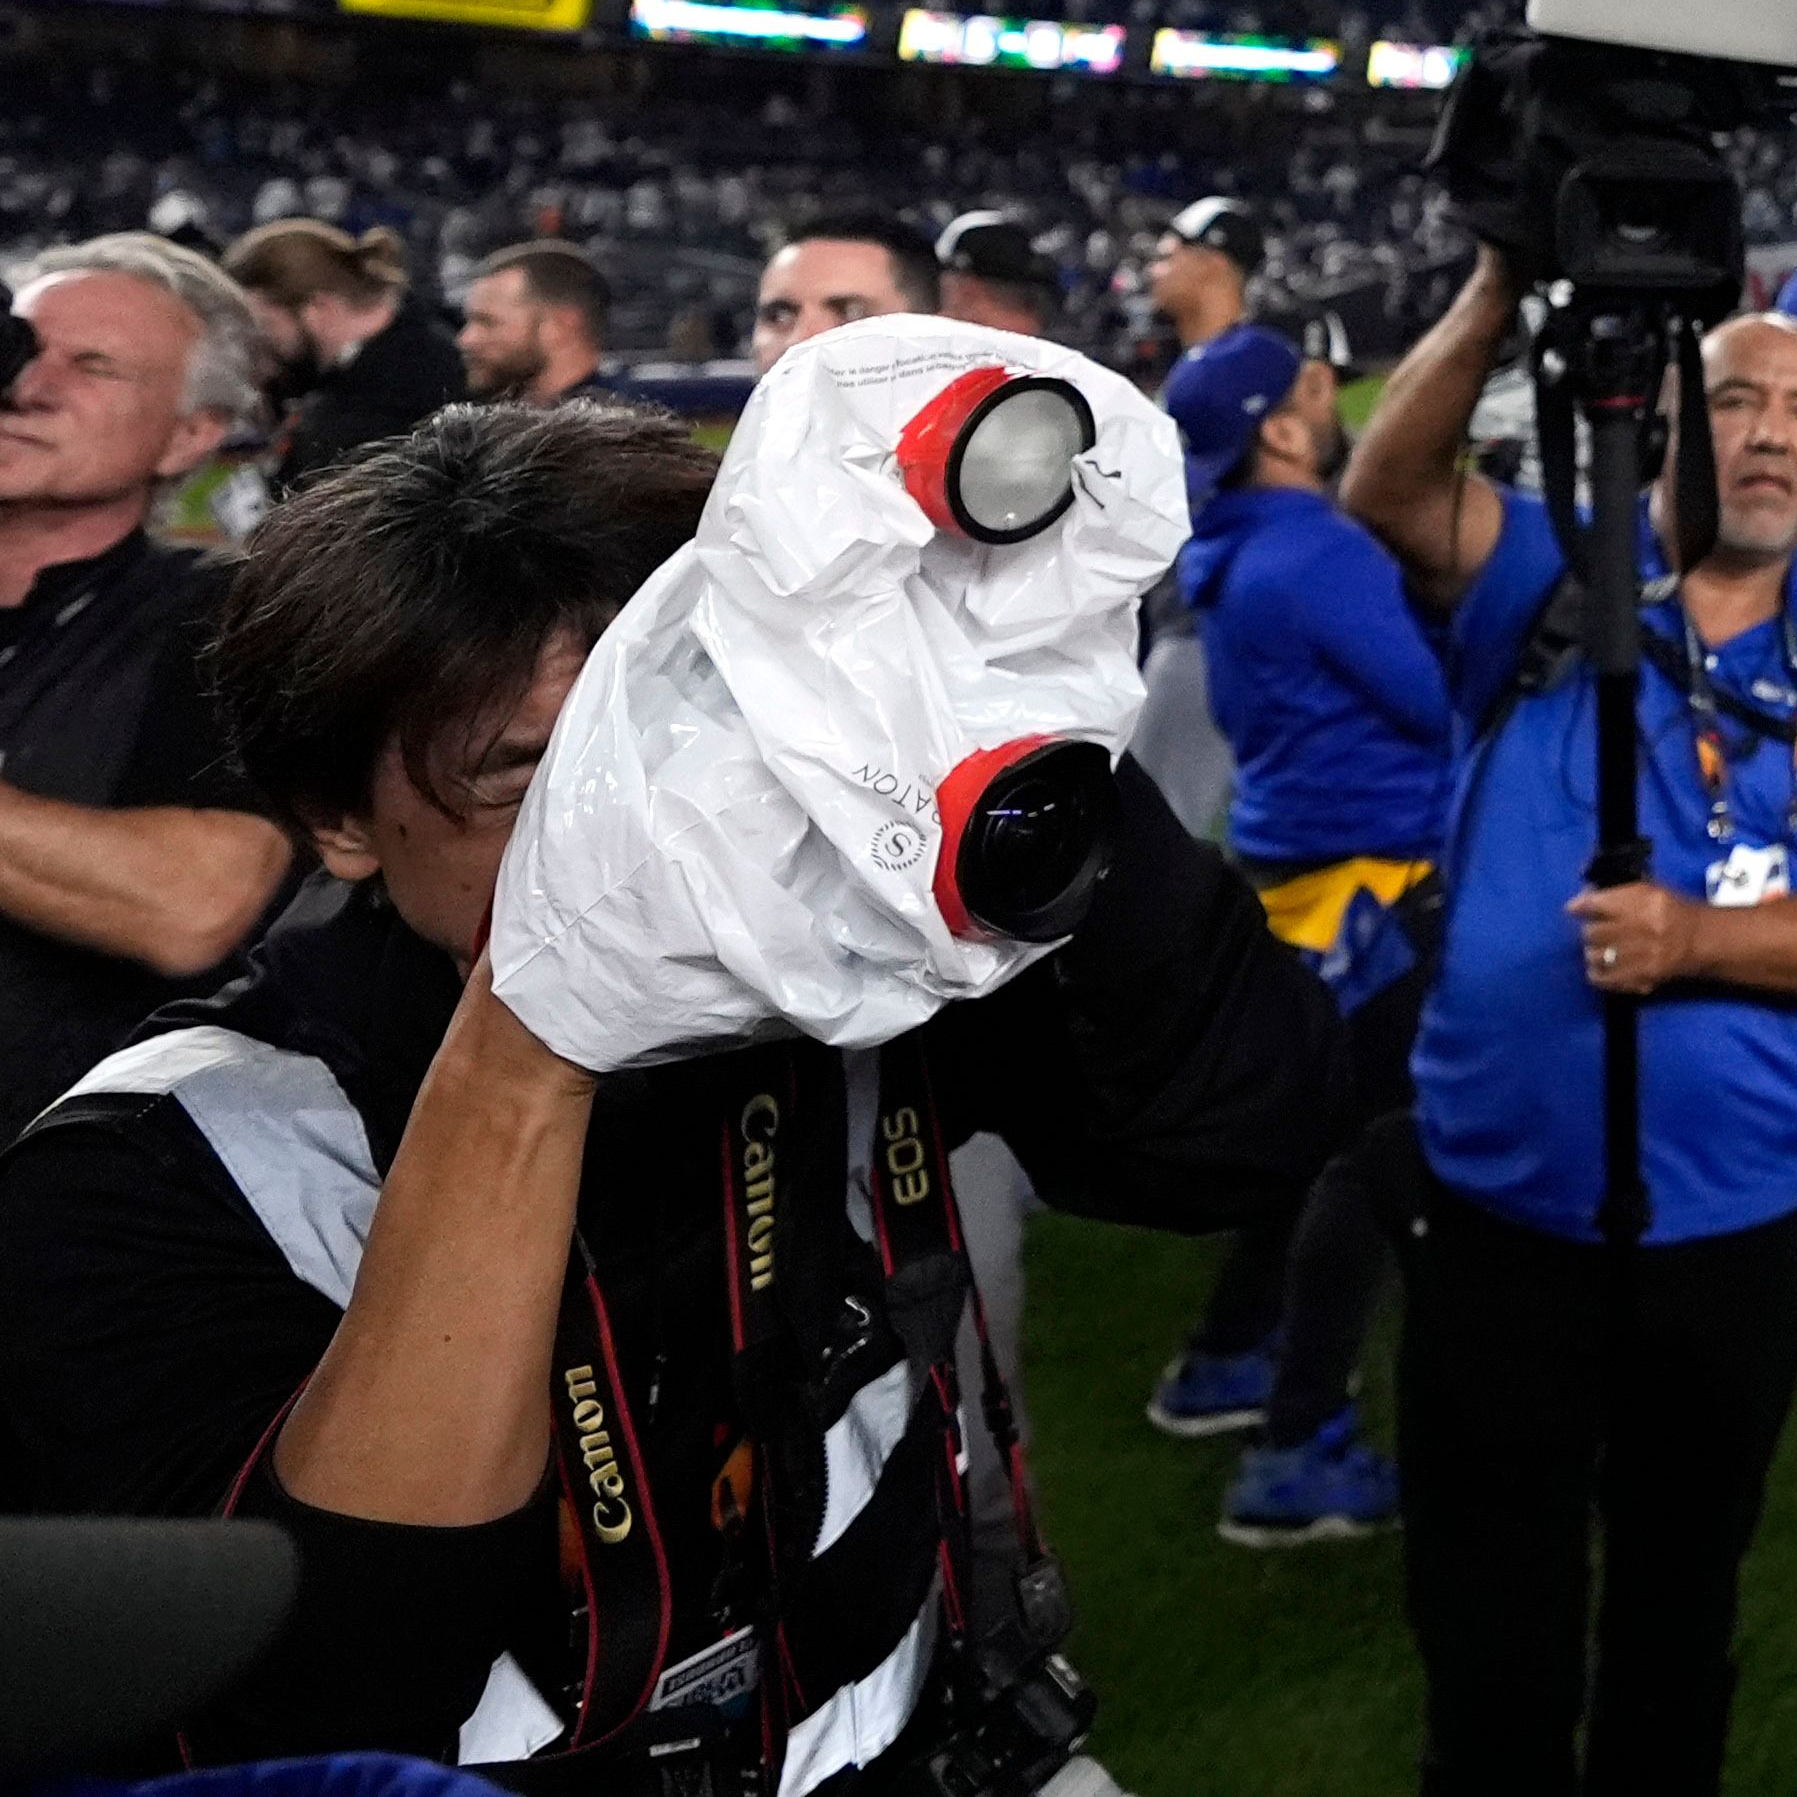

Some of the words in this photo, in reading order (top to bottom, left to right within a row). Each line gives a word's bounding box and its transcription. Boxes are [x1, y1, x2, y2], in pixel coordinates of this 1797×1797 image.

[740, 1093, 780, 1292] Canon
[883, 1106, 930, 1205] EOS
[563, 1364, 632, 1544] Canon
